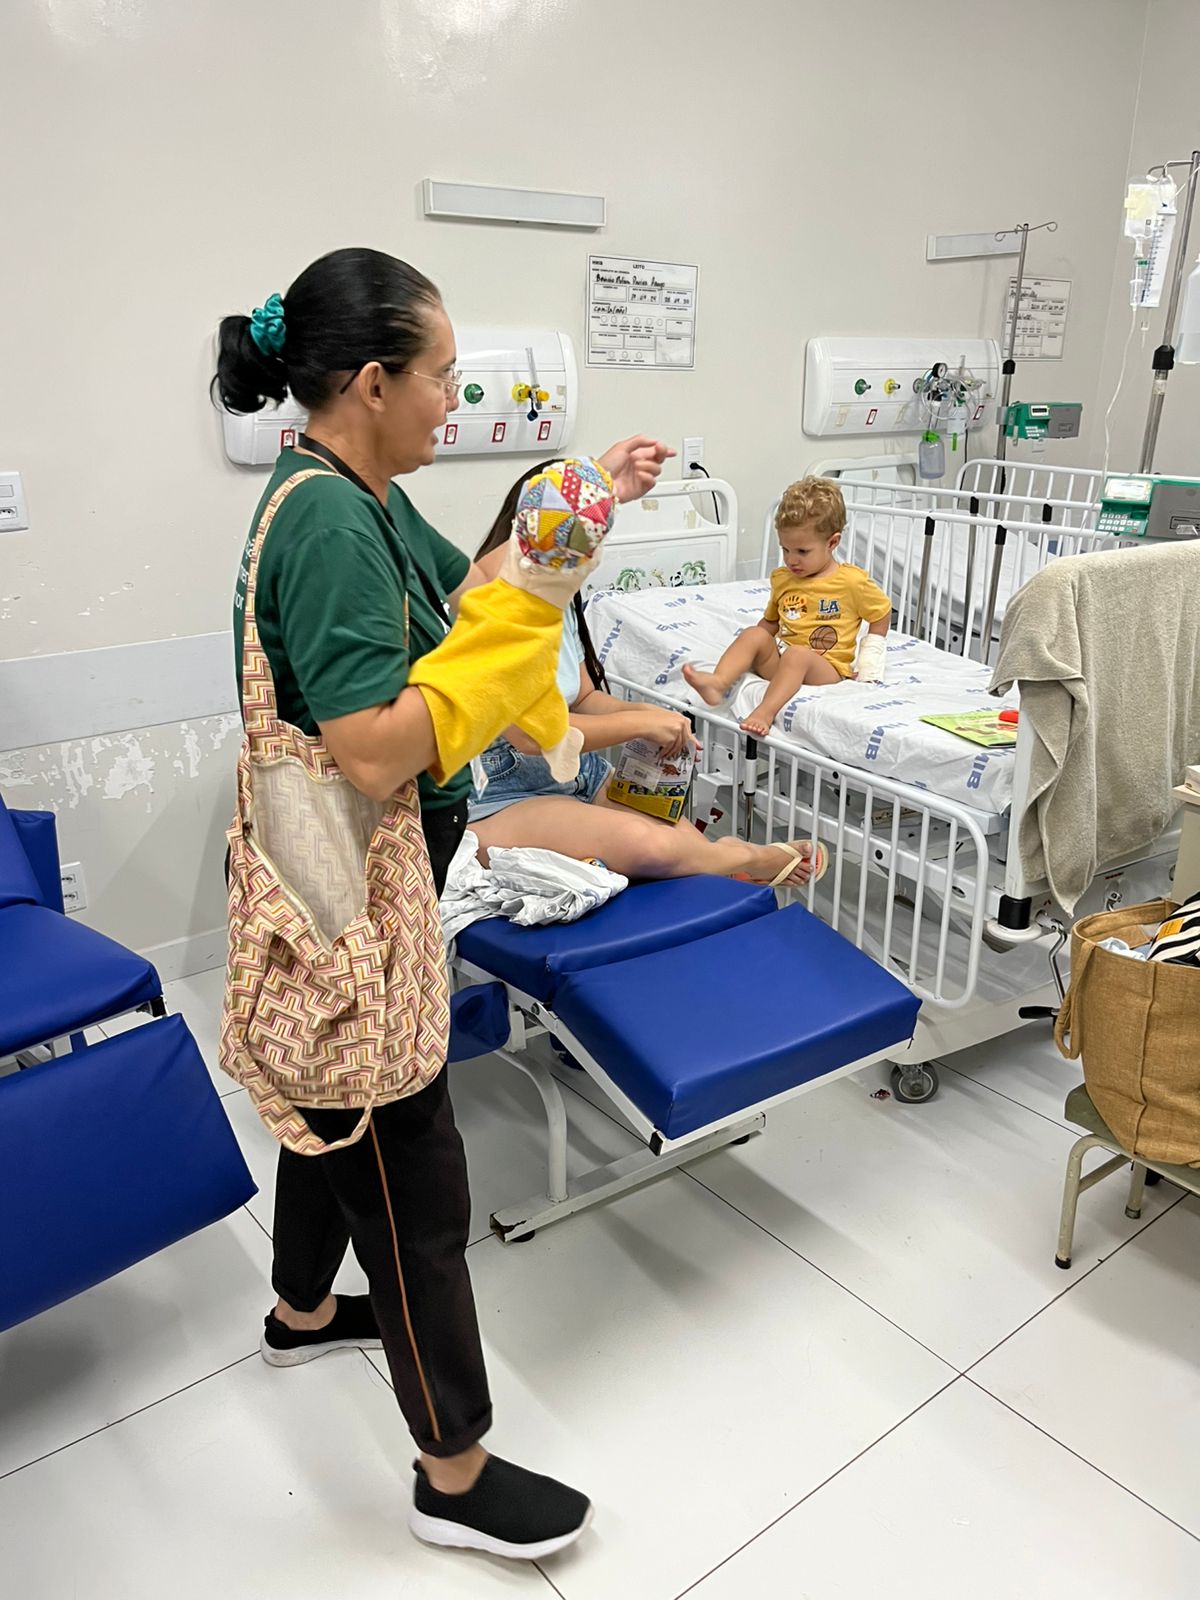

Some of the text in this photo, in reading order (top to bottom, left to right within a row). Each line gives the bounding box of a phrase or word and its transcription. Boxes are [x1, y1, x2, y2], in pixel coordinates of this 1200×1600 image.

[819, 598, 840, 614] LA
[783, 694, 822, 733] HMIB
[864, 721, 910, 761] HMIB
